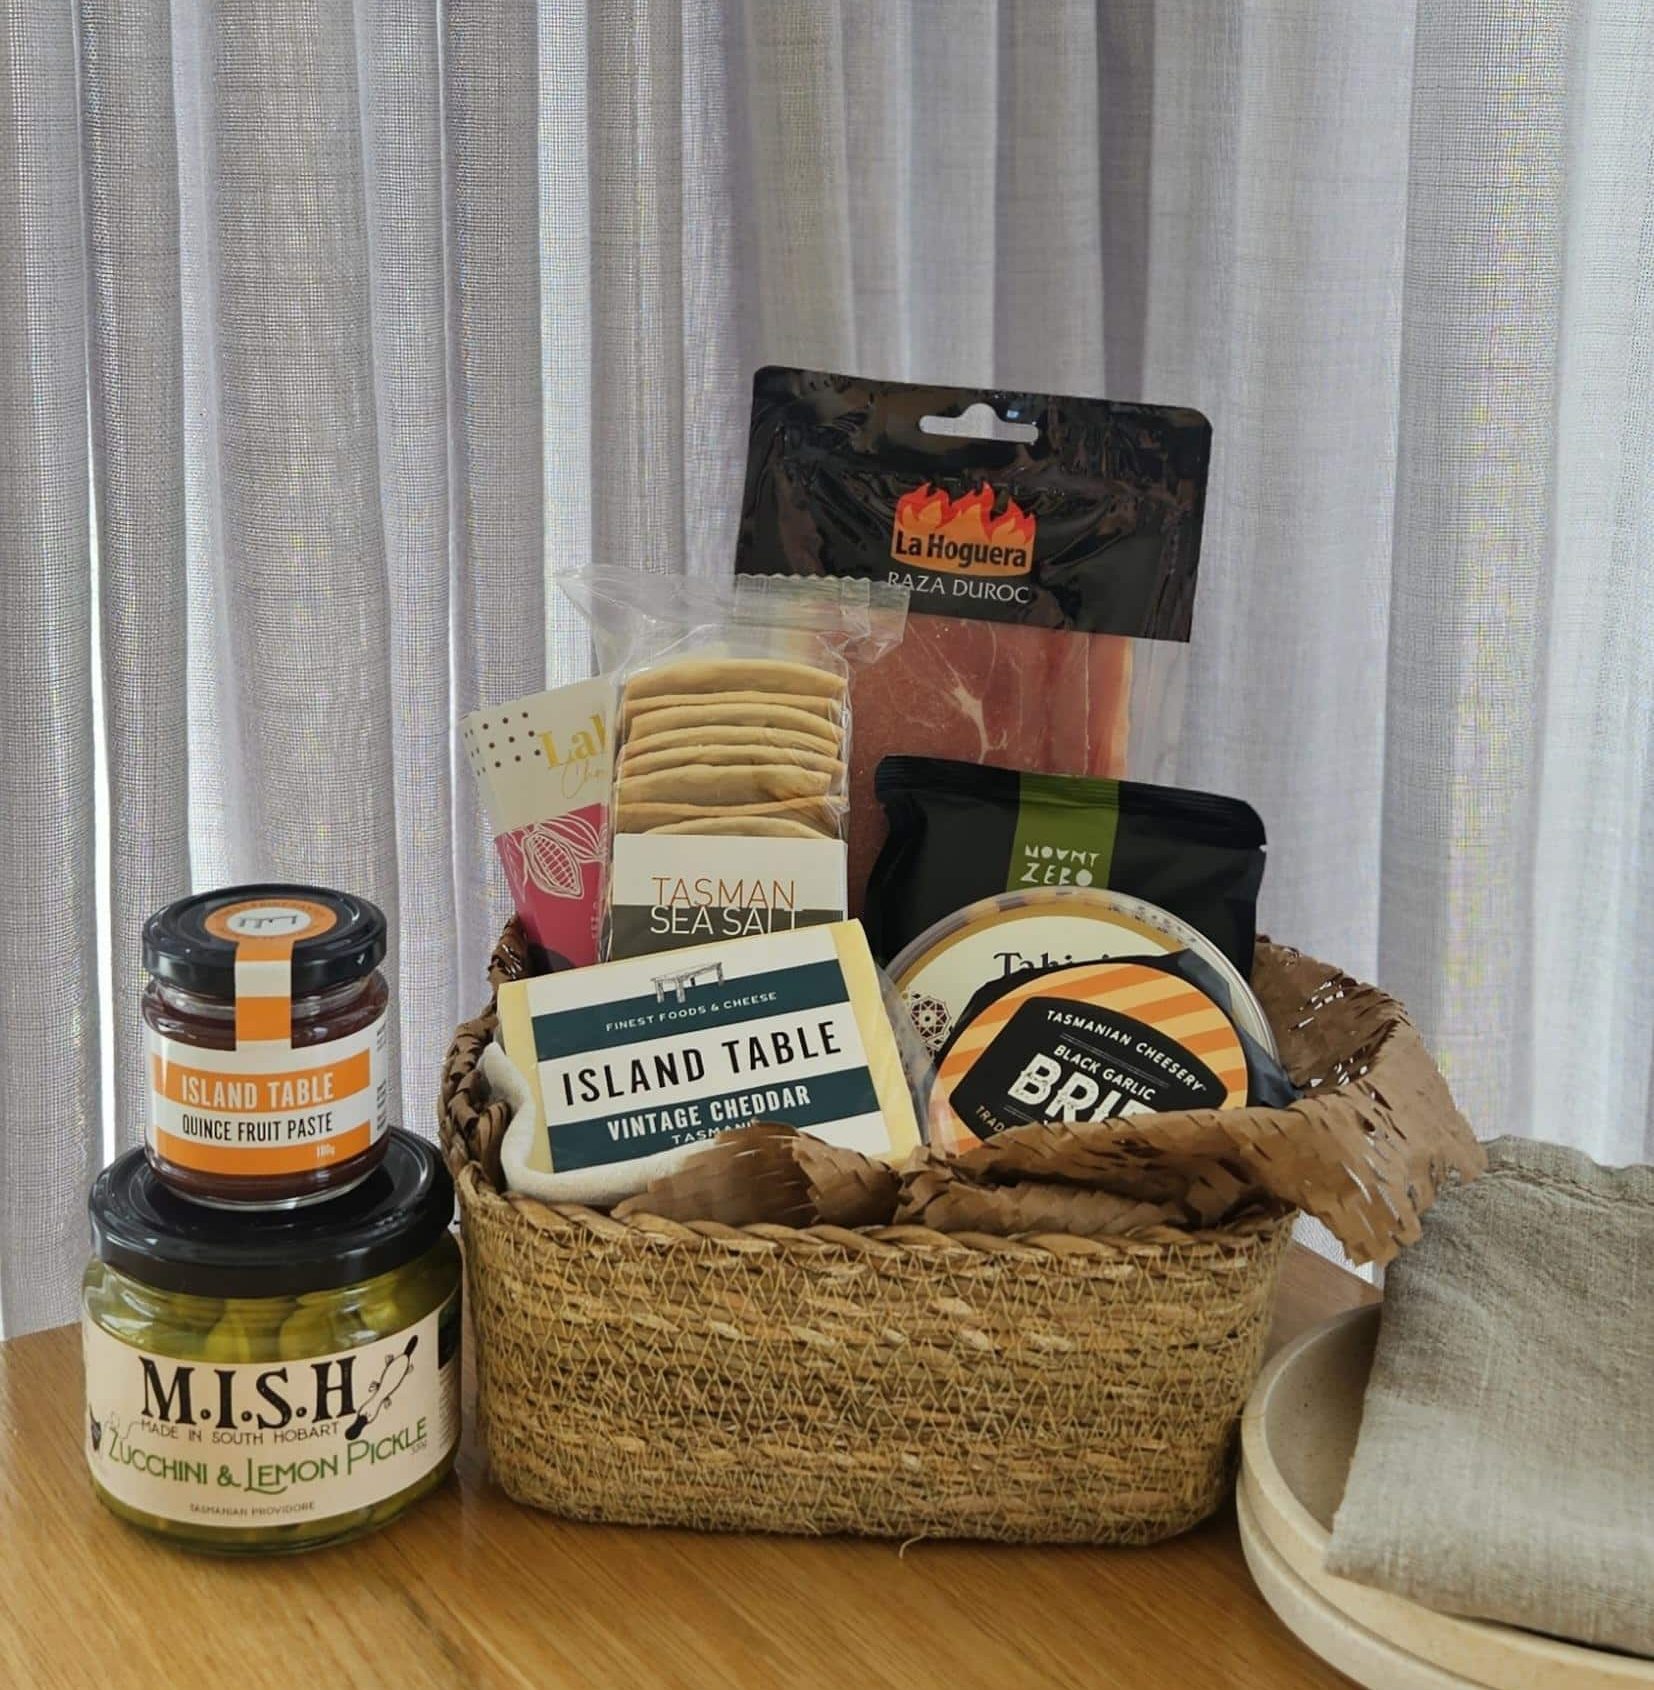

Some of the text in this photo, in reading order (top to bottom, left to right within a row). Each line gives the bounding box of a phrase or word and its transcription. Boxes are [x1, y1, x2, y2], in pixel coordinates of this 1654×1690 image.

[896, 532, 1027, 568] La Hoguera
[889, 571, 1030, 604] RAZA DUROC
[1025, 844, 1101, 867] MOUNT
[1020, 862, 1093, 887] ZERO
[651, 877, 795, 909] TASMAN
[650, 905, 714, 935] SEA
[606, 991, 778, 1032] FINEST FOODS & CHEESE
[562, 1021, 842, 1106] ISLAND TABLE
[1046, 1009, 1204, 1092] TASMANIAN CHEESERY
[181, 1071, 335, 1110] ISLAND TABLE
[1053, 1043, 1157, 1102] BLACK GARLIC
[182, 1111, 334, 1143] QUINCE FRUIT PASTE
[607, 1084, 811, 1142] VINTAGE CHEDDAR
[138, 1354, 358, 1430] M.I.S.H
[140, 1418, 340, 1446] MADE IN SOUTH HOBART
[107, 1416, 428, 1496] ZUCCHINI & LEMON PICKLE
[190, 1500, 315, 1516] TASMANIAN PROVIDORE
